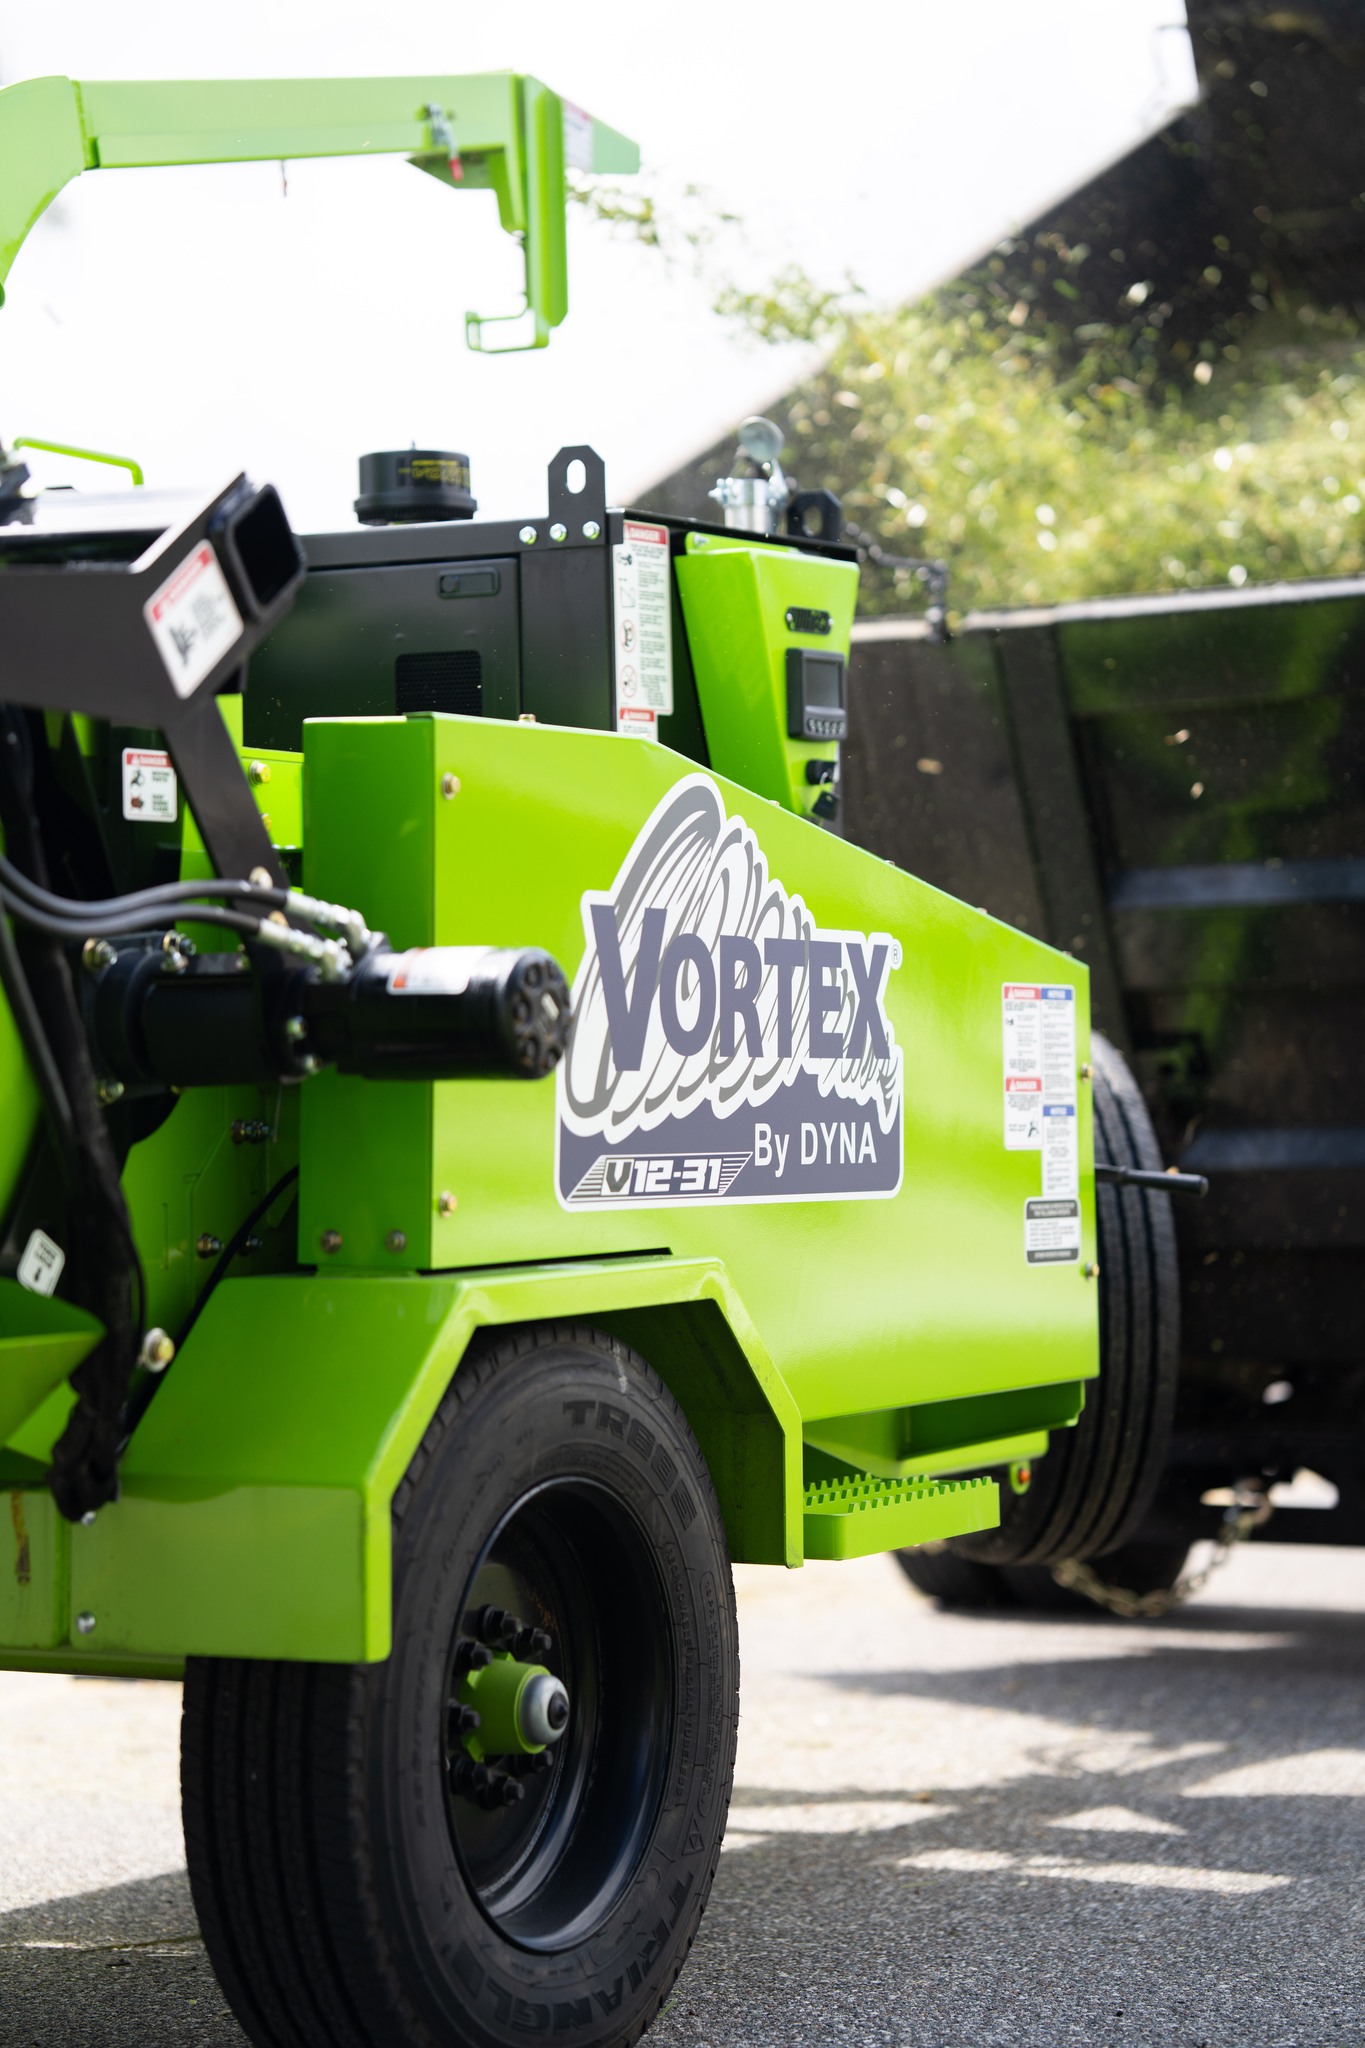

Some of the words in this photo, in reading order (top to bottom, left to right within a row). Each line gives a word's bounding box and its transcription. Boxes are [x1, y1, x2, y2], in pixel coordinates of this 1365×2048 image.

[590, 904, 890, 1072] VORTEX
[604, 1158, 722, 1193] V12-31
[754, 1123, 789, 1178] By
[801, 1122, 877, 1166] DYNA
